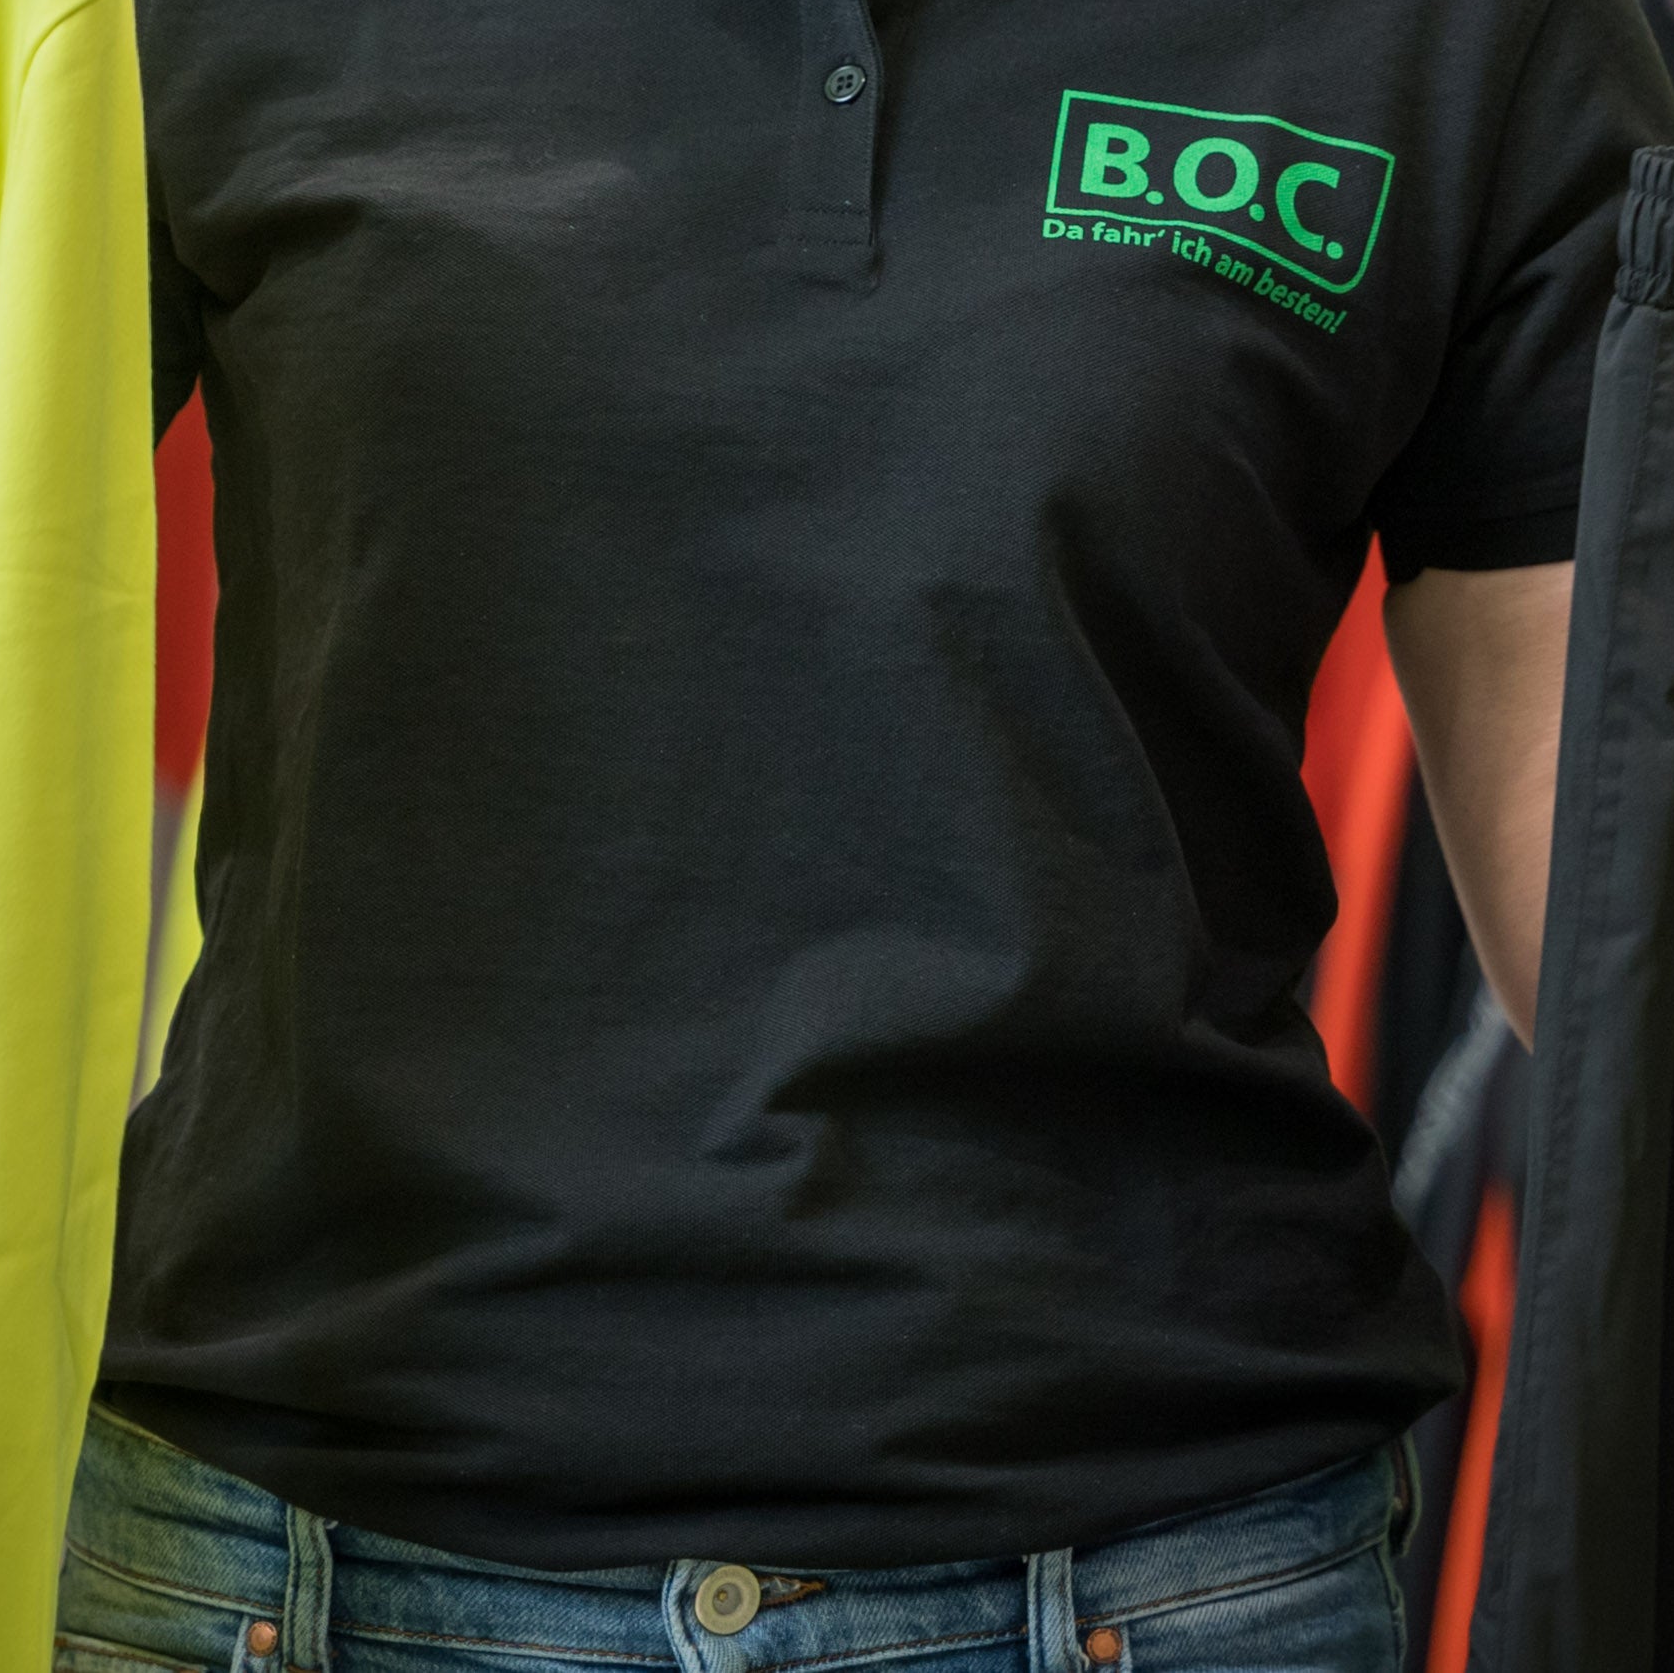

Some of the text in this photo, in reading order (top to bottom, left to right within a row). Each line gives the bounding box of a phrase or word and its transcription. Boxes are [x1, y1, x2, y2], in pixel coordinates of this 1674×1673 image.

[1079, 122, 1345, 260] B.O.C.
[1041, 218, 1084, 241] Da
[1171, 231, 1213, 268] ich
[1214, 253, 1255, 287] am
[1253, 268, 1348, 334] besten!
